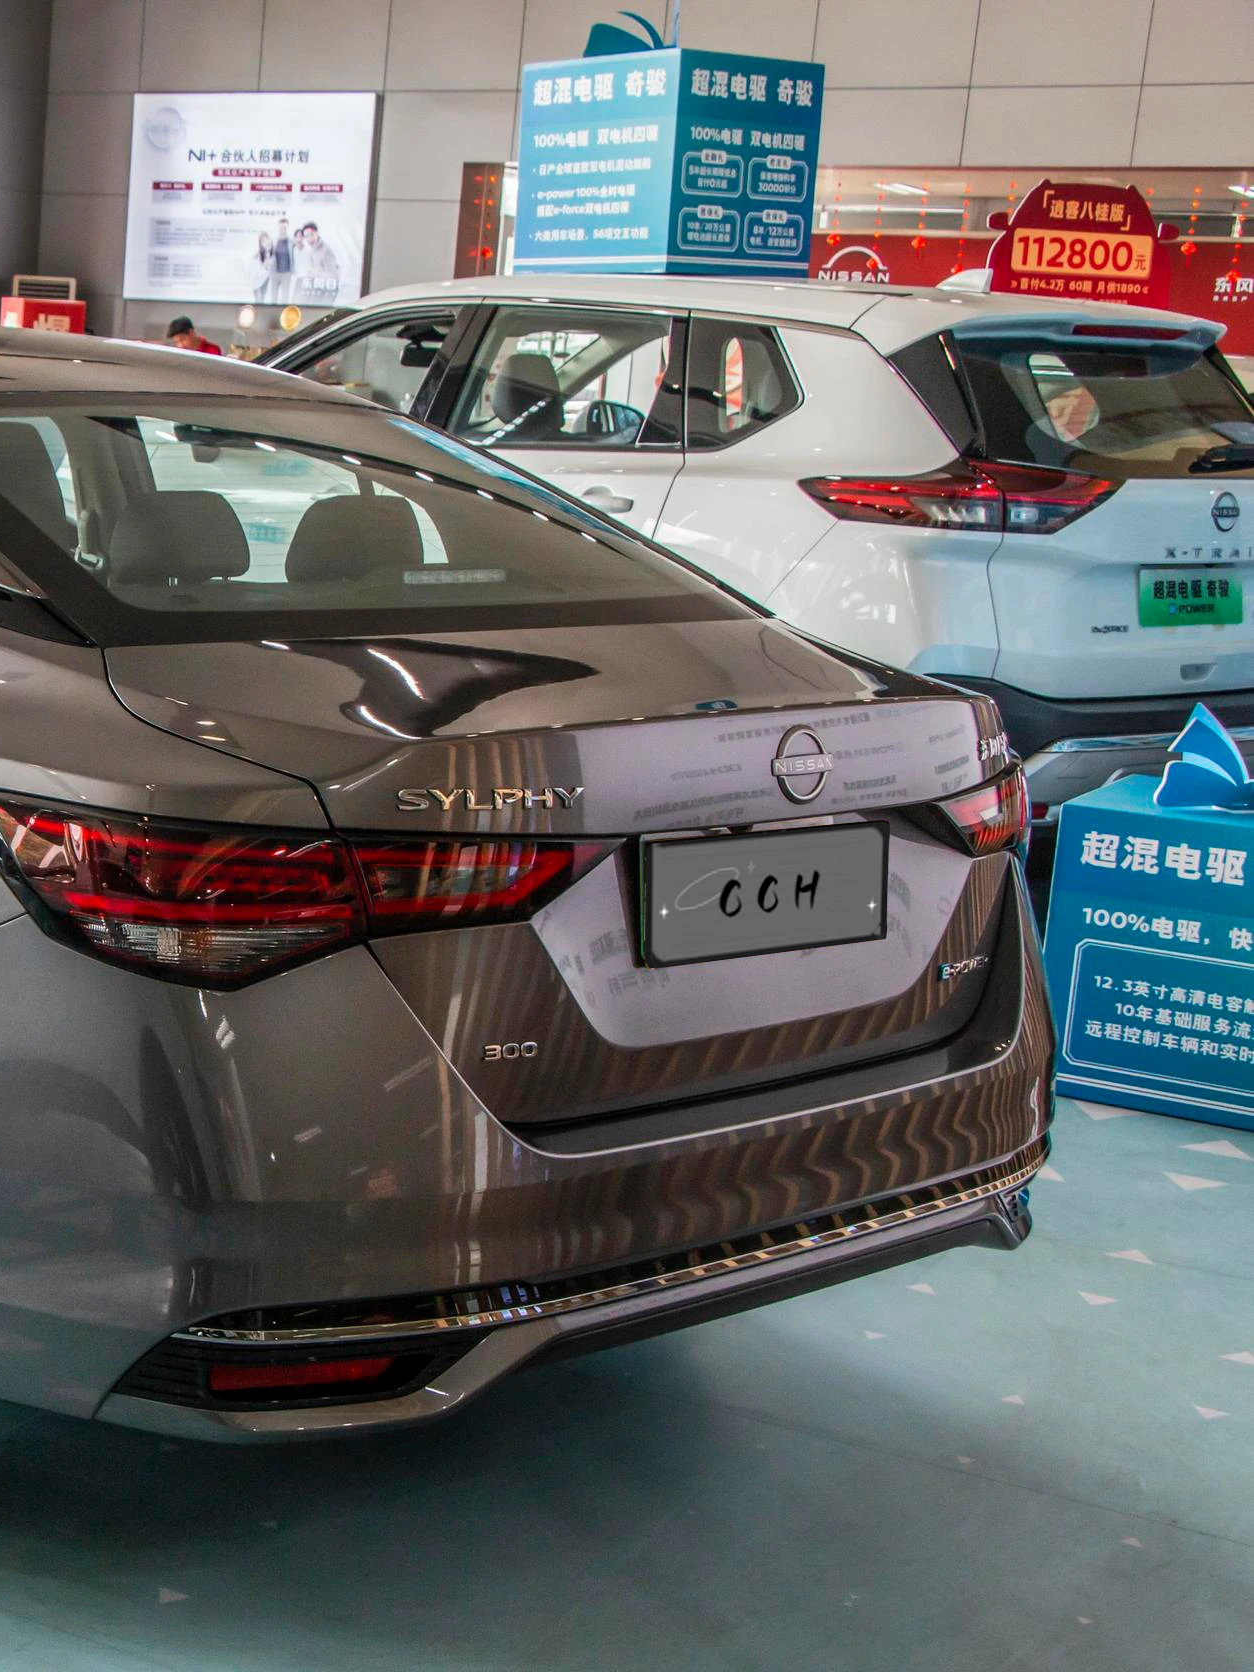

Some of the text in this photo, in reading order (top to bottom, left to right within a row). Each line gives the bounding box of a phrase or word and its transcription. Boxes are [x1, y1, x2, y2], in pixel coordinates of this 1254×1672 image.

[533, 68, 666, 106] 超混电驱 奇骏
[691, 68, 813, 107] 超混电驱 奇骏
[534, 124, 659, 148] 100%电驱 双电机四驱
[690, 125, 806, 151] 100%电驱 双电机四驱
[818, 270, 890, 283] NISSAN
[1020, 277, 1141, 294] 首付4.2万 60期 月供1890
[1214, 277, 1254, 293] 东风
[1153, 580, 1229, 599] 超混电驱 奇骏
[774, 756, 833, 773] NISSAN
[397, 787, 586, 811] SYLPHY
[1080, 830, 1247, 886] 超混电驱
[1115, 1002, 1254, 1040] 10年基础服务流
[484, 1041, 538, 1060] 300
